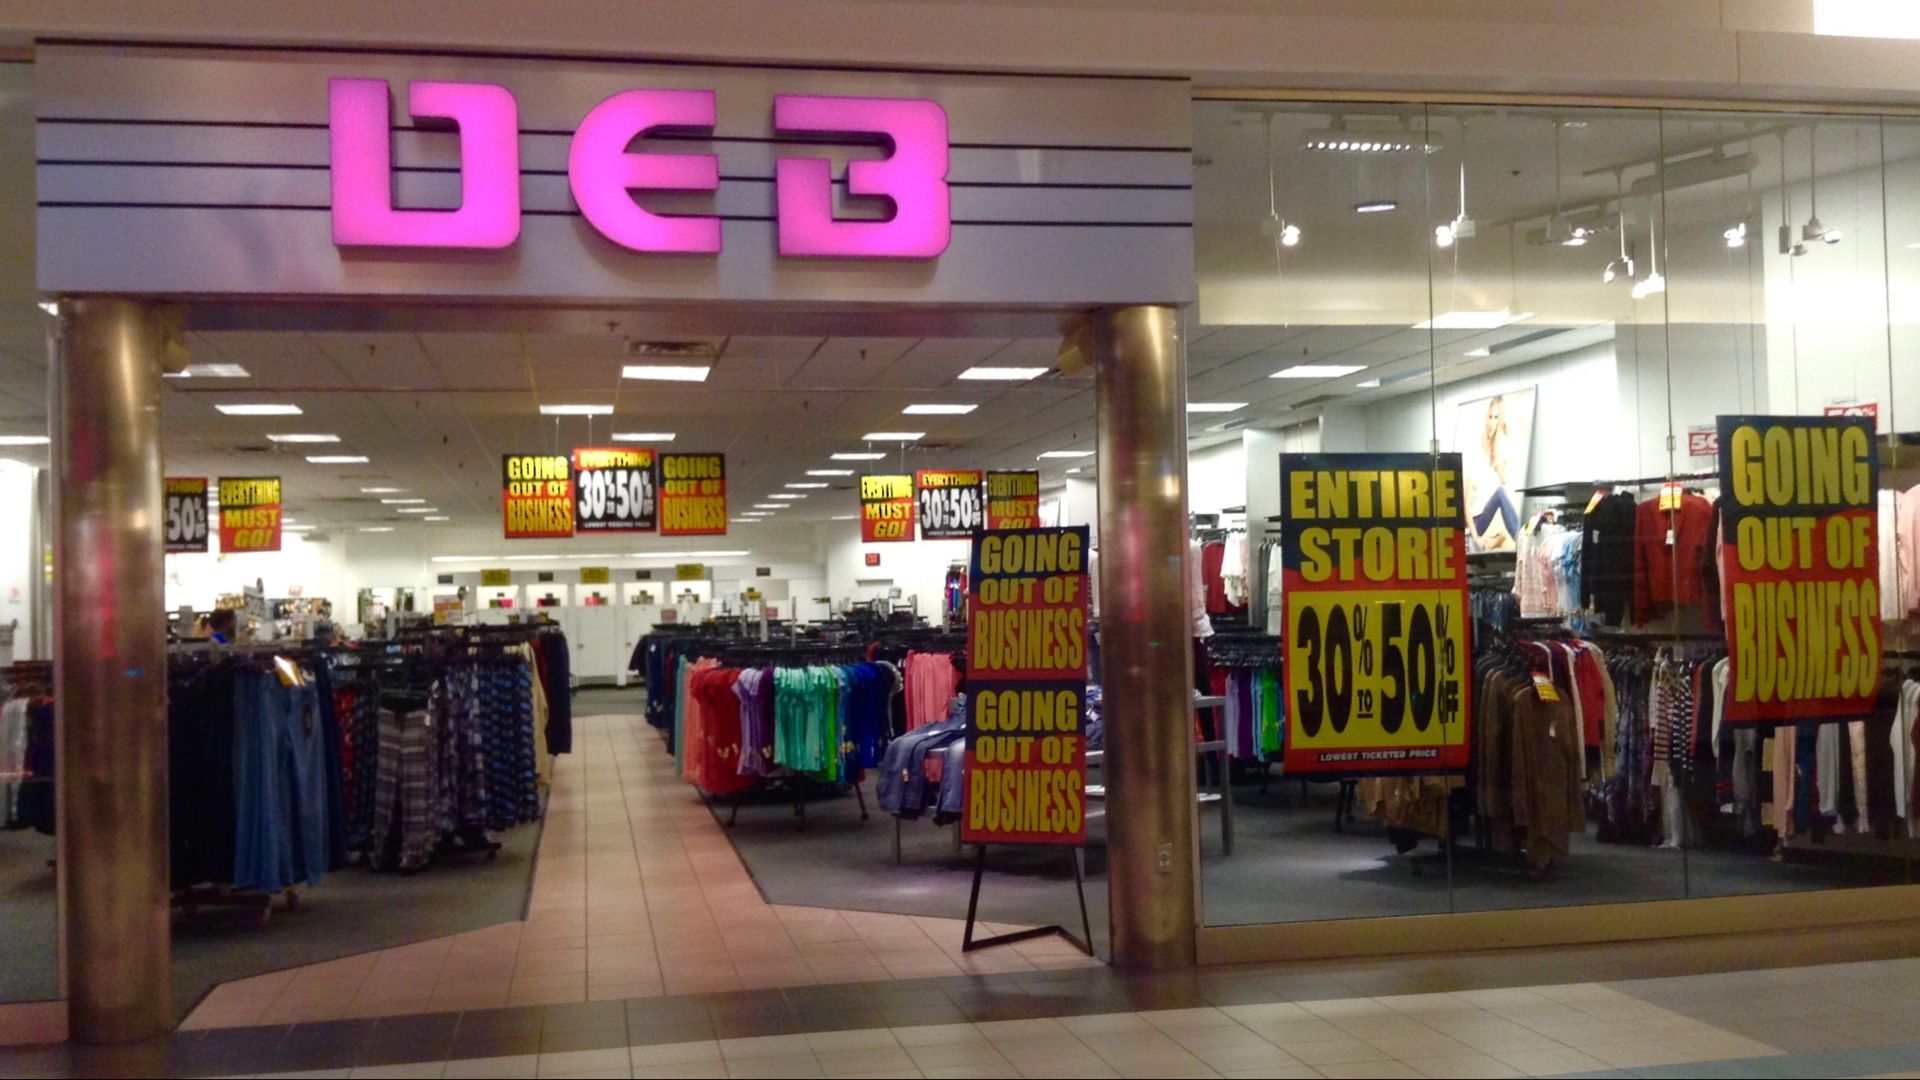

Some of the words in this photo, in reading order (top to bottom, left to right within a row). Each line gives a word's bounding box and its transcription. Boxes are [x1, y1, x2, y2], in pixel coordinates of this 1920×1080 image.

[328, 78, 951, 257] DEB
[508, 456, 568, 480] GOING
[663, 456, 721, 479] GOING
[1731, 426, 1870, 506] GOING
[510, 481, 543, 497] OUT
[547, 480, 568, 497] OF
[665, 480, 698, 495] OUT
[702, 480, 721, 495] OF
[1290, 470, 1457, 519] ENTIRE
[224, 509, 279, 528] MUST
[508, 498, 571, 532] BUSINESS
[663, 496, 724, 530] BUSINESS
[866, 502, 911, 520] MUST
[991, 500, 1036, 517] MUST
[234, 529, 273, 548] GO!
[874, 521, 907, 538] GO!
[1737, 516, 1815, 571] OUT
[1825, 515, 1870, 569] OF
[980, 531, 1081, 575] GOING
[1300, 526, 1456, 583] STORE
[979, 577, 1037, 605] OUT
[1044, 576, 1079, 604] OF
[974, 608, 1083, 670] BUSINESS
[1734, 578, 1877, 703] BUSINESS
[1297, 603, 1373, 738] 30%
[1357, 688, 1373, 713] TO
[1381, 602, 1455, 735] 50%
[1438, 680, 1459, 724] OFF
[975, 690, 1077, 731] GOING
[976, 737, 1034, 765] OUT
[1041, 735, 1077, 765] OF
[1320, 752, 1359, 762] LOWEST
[1361, 750, 1406, 760] TICKETED
[1408, 748, 1437, 758] PRICE
[969, 768, 1082, 834] BUSINESS
